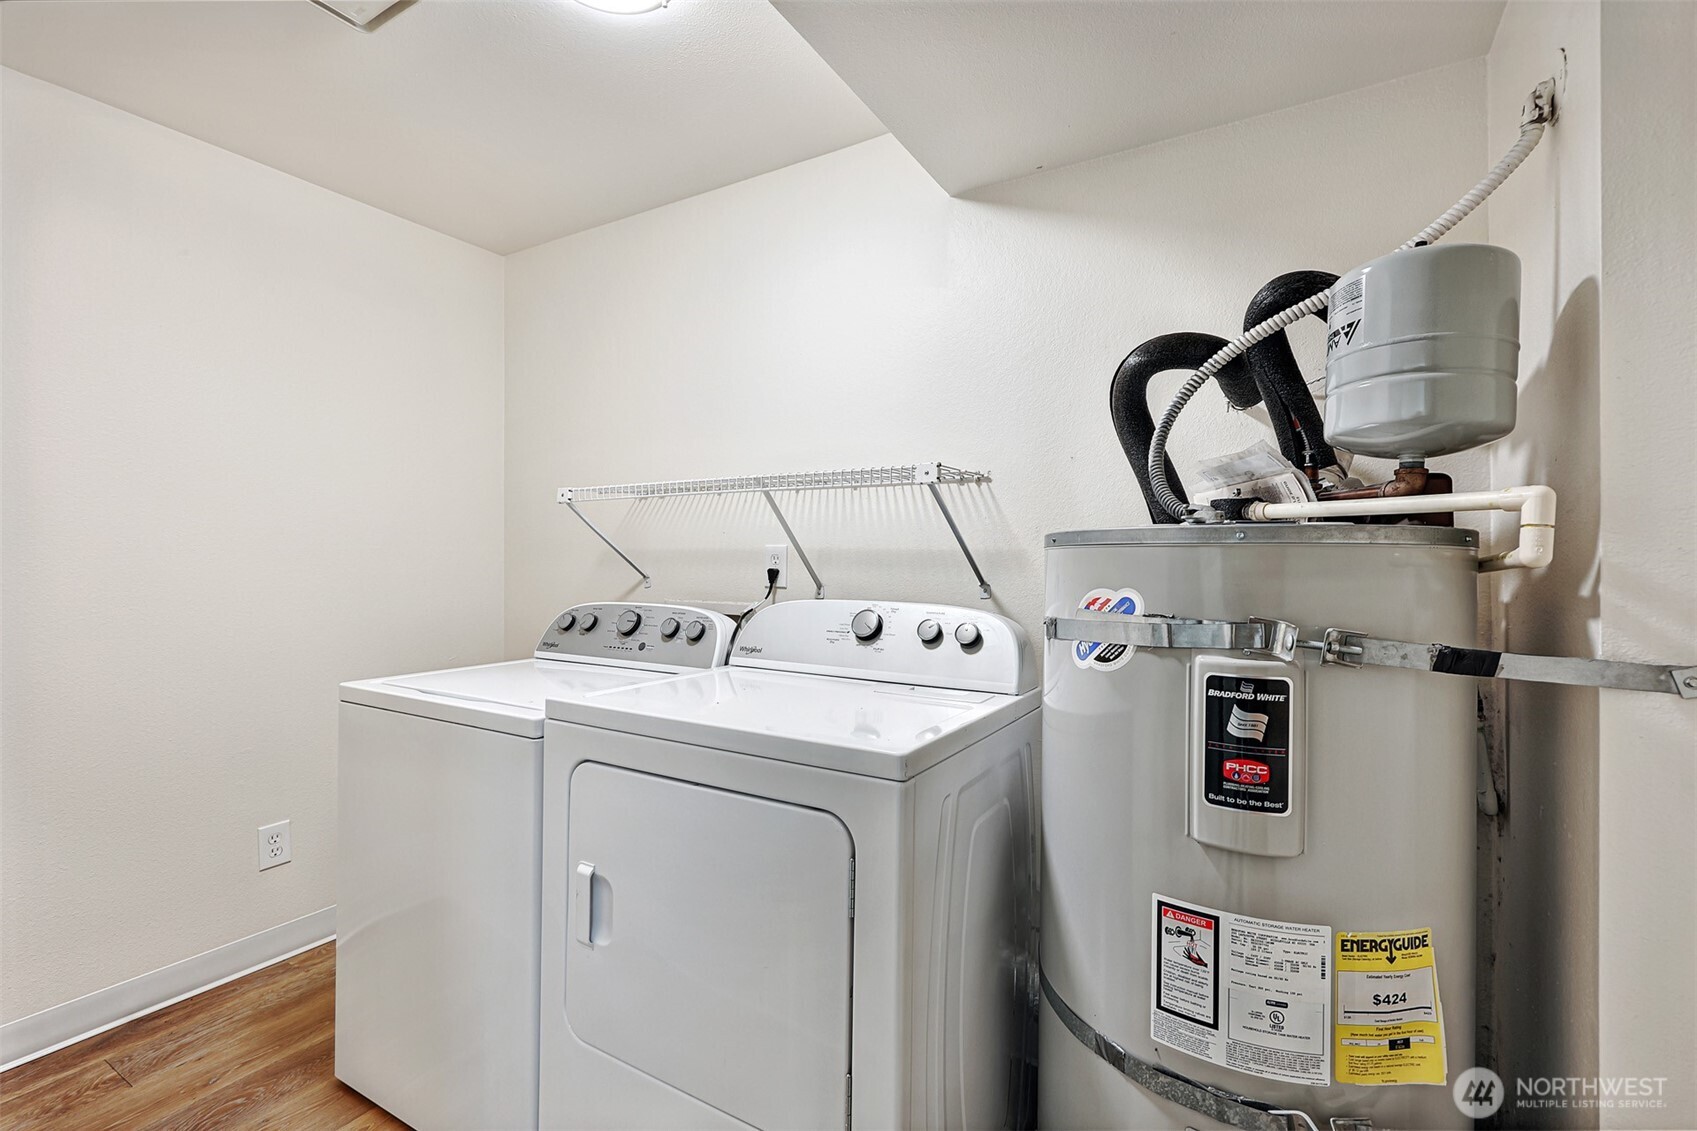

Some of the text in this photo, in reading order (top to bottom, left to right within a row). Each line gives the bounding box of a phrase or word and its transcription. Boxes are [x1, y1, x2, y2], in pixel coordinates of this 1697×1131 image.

[740, 645, 763, 655] Whirlpool
[1207, 689, 1287, 702] BRADFORD WHITE
[1225, 762, 1268, 774] PHCC
[1208, 793, 1226, 802] Built
[1249, 799, 1262, 807] the
[1175, 913, 1207, 927] DANGER
[1234, 918, 1261, 927] AUTOMATIC
[1261, 922, 1284, 930] STORAGE
[1341, 934, 1429, 954] ENERGYGUIDE
[1372, 992, 1408, 1006] $424
[1272, 1013, 1281, 1022] UL
[1242, 1025, 1262, 1033] HOUSEHOLD
